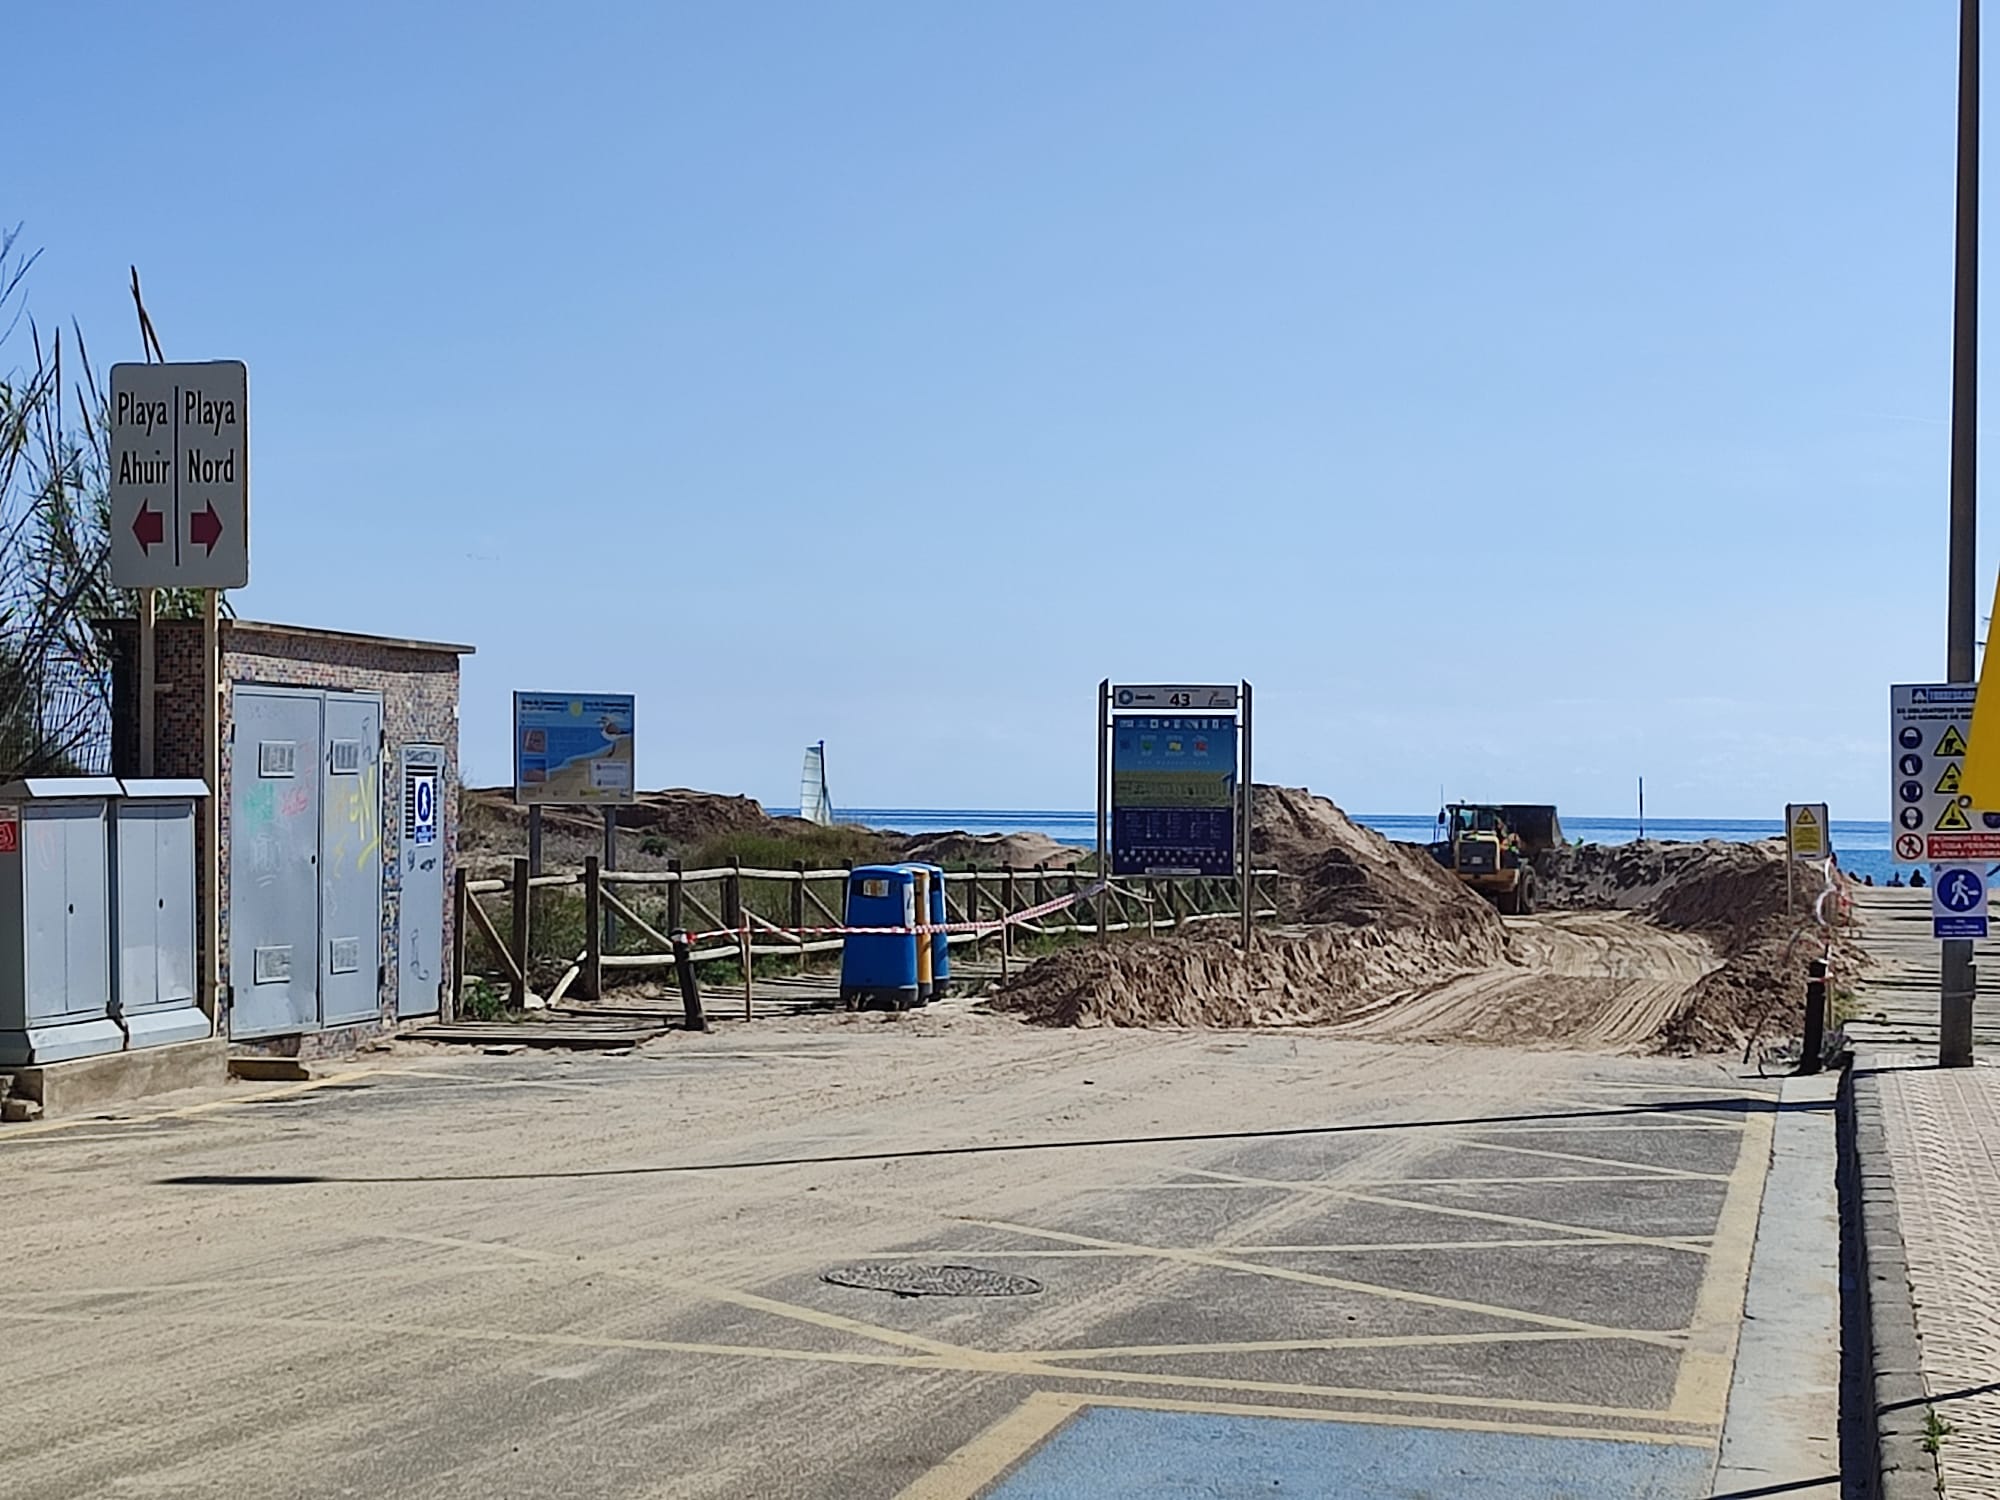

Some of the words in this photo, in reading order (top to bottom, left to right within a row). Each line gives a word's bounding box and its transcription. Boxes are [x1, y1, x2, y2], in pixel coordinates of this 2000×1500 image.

[118, 391, 168, 437] Playa
[185, 390, 236, 436] Playa
[118, 449, 171, 485] Ahuir
[188, 448, 234, 483] Nord
[1169, 692, 1190, 706] 43
